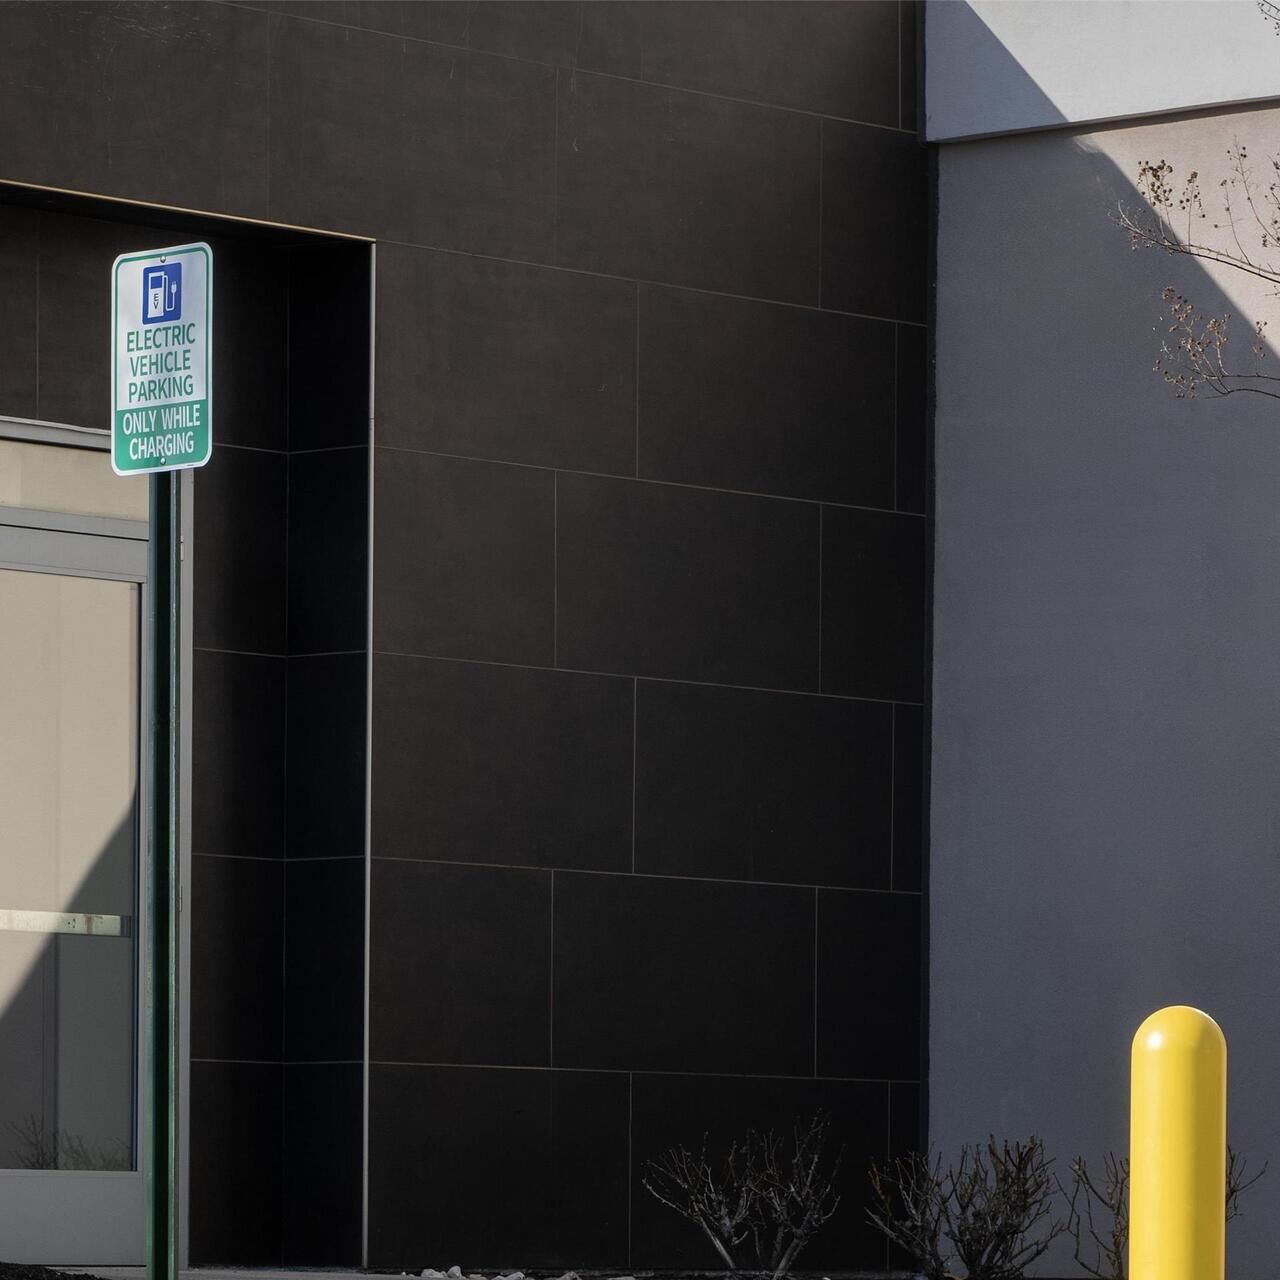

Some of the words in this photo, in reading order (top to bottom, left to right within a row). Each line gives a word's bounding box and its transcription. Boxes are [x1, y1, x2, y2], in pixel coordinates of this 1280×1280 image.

[127, 323, 196, 352] ELECTRIC
[130, 350, 191, 376] VEHICLE
[128, 375, 194, 403] PARKING
[123, 409, 157, 435] ONLY
[161, 404, 200, 430] WHILE
[129, 432, 194, 460] CHARGING
